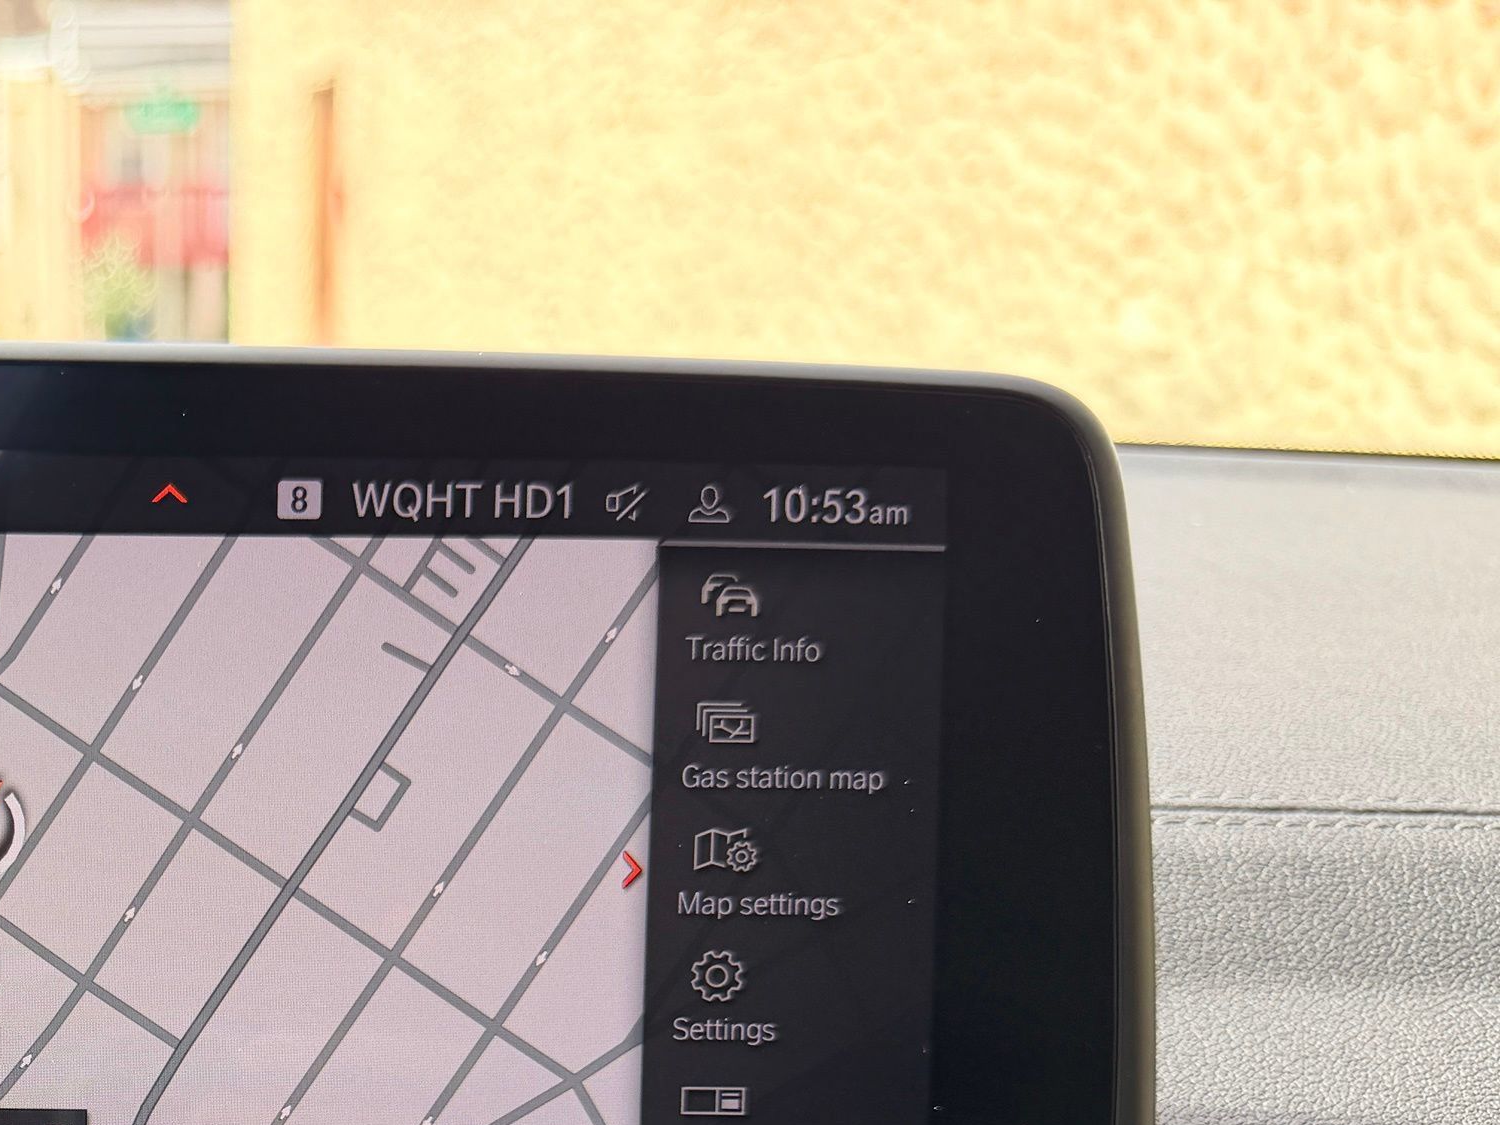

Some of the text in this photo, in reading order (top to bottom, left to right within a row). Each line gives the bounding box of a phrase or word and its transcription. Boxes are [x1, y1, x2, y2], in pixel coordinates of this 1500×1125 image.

[289, 485, 308, 514] 8
[352, 483, 572, 522] WQHT HD1
[686, 636, 822, 663] Traffic Info
[681, 764, 885, 795] Gas station map
[677, 891, 840, 921] Map settings
[672, 1016, 776, 1046] Settings
